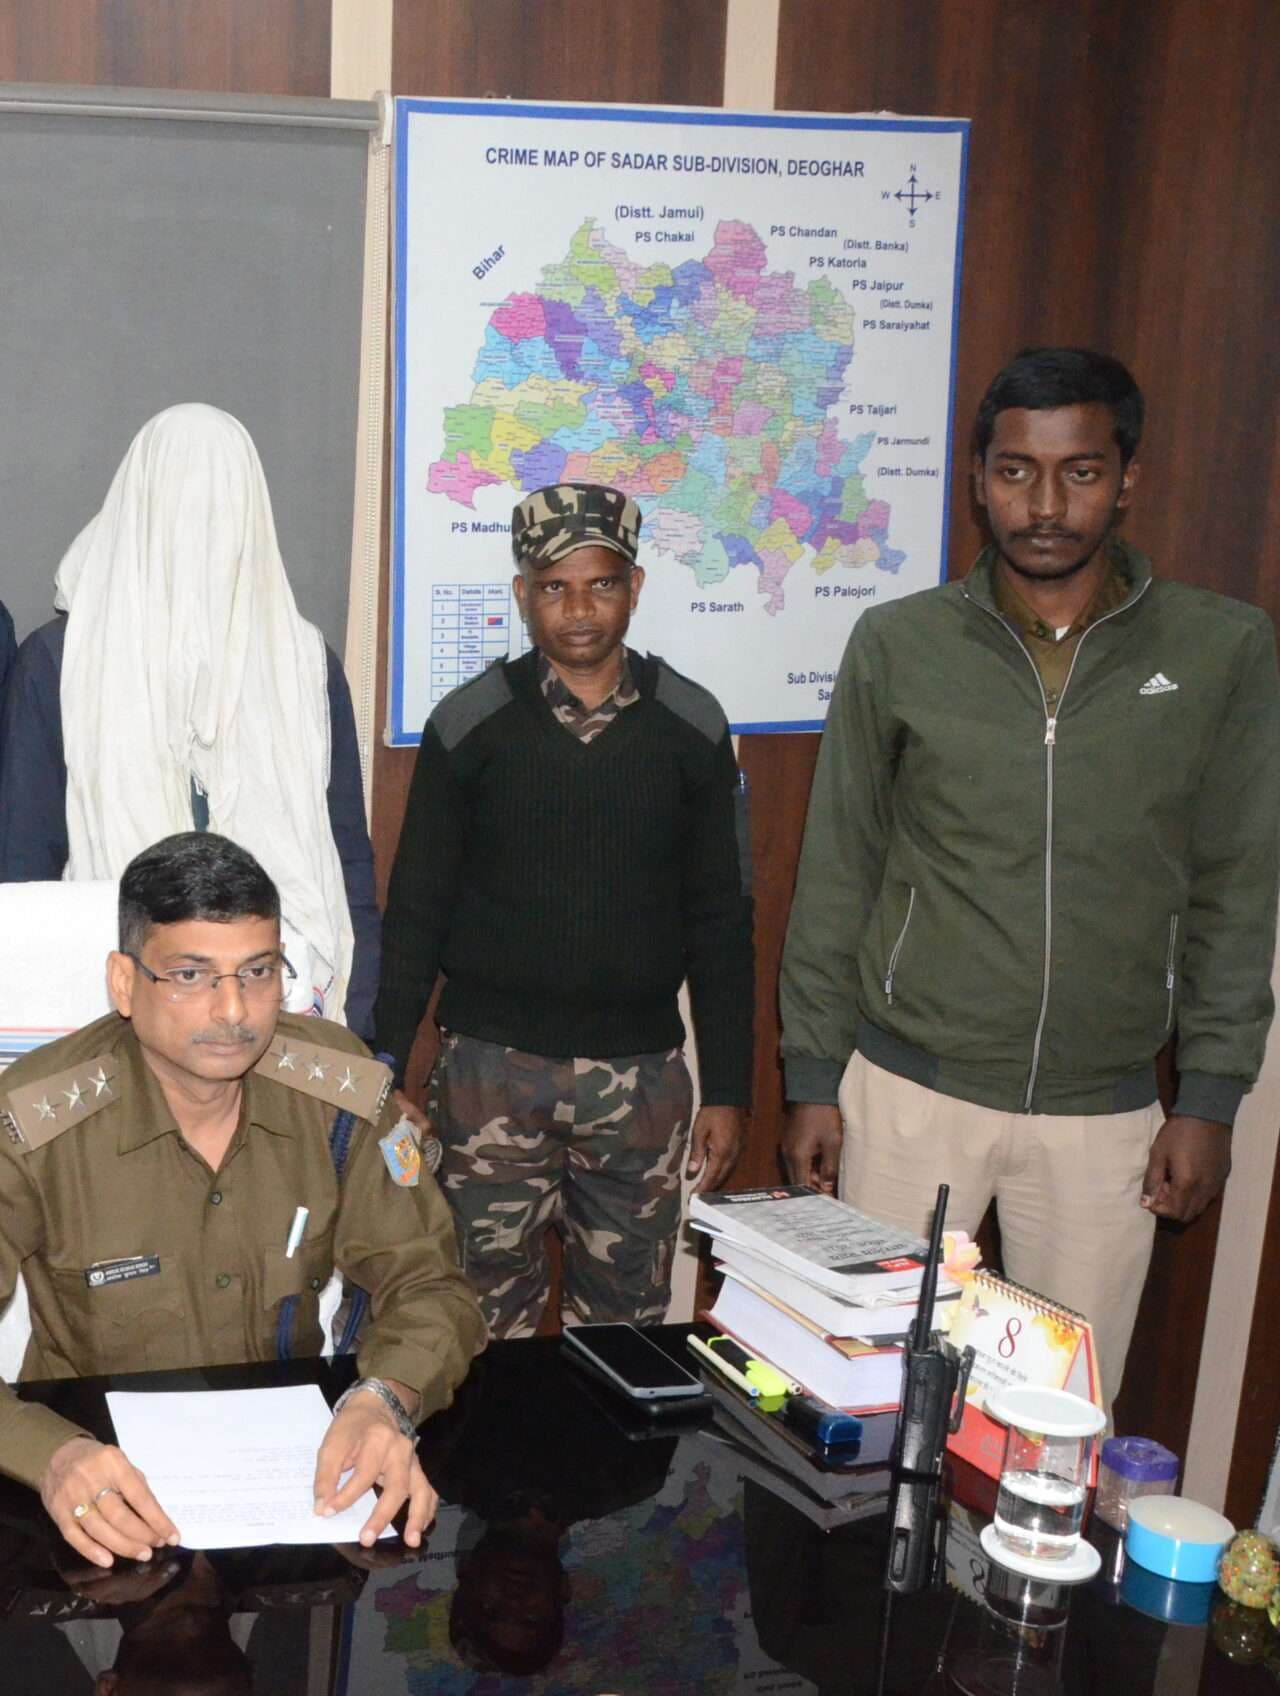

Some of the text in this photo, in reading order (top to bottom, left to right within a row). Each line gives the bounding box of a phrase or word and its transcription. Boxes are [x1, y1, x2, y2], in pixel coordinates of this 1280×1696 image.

[485, 147, 865, 177] CRIME MAP OF SADAR SUB-DIVISION, DEOGHAR
[910, 163, 917, 172] N
[614, 205, 705, 221] (Distt. Jamui)
[634, 231, 695, 242] PS Chakai
[770, 225, 838, 238] PS Chandan
[874, 240, 909, 253] Banka)
[472, 244, 505, 280] Bihar
[808, 256, 867, 268] PS Katoria
[852, 279, 904, 292] PS Jaipur
[862, 319, 877, 330] PS
[849, 404, 864, 414] PS
[877, 436, 889, 445] PS
[451, 521, 512, 533] PS Madhu
[815, 585, 876, 599] PS Palojori
[690, 601, 744, 612] PS Sarath
[787, 671, 837, 684] Sub Divisi
[817, 689, 832, 701] Sa
[997, 1316, 1023, 1359] 8
